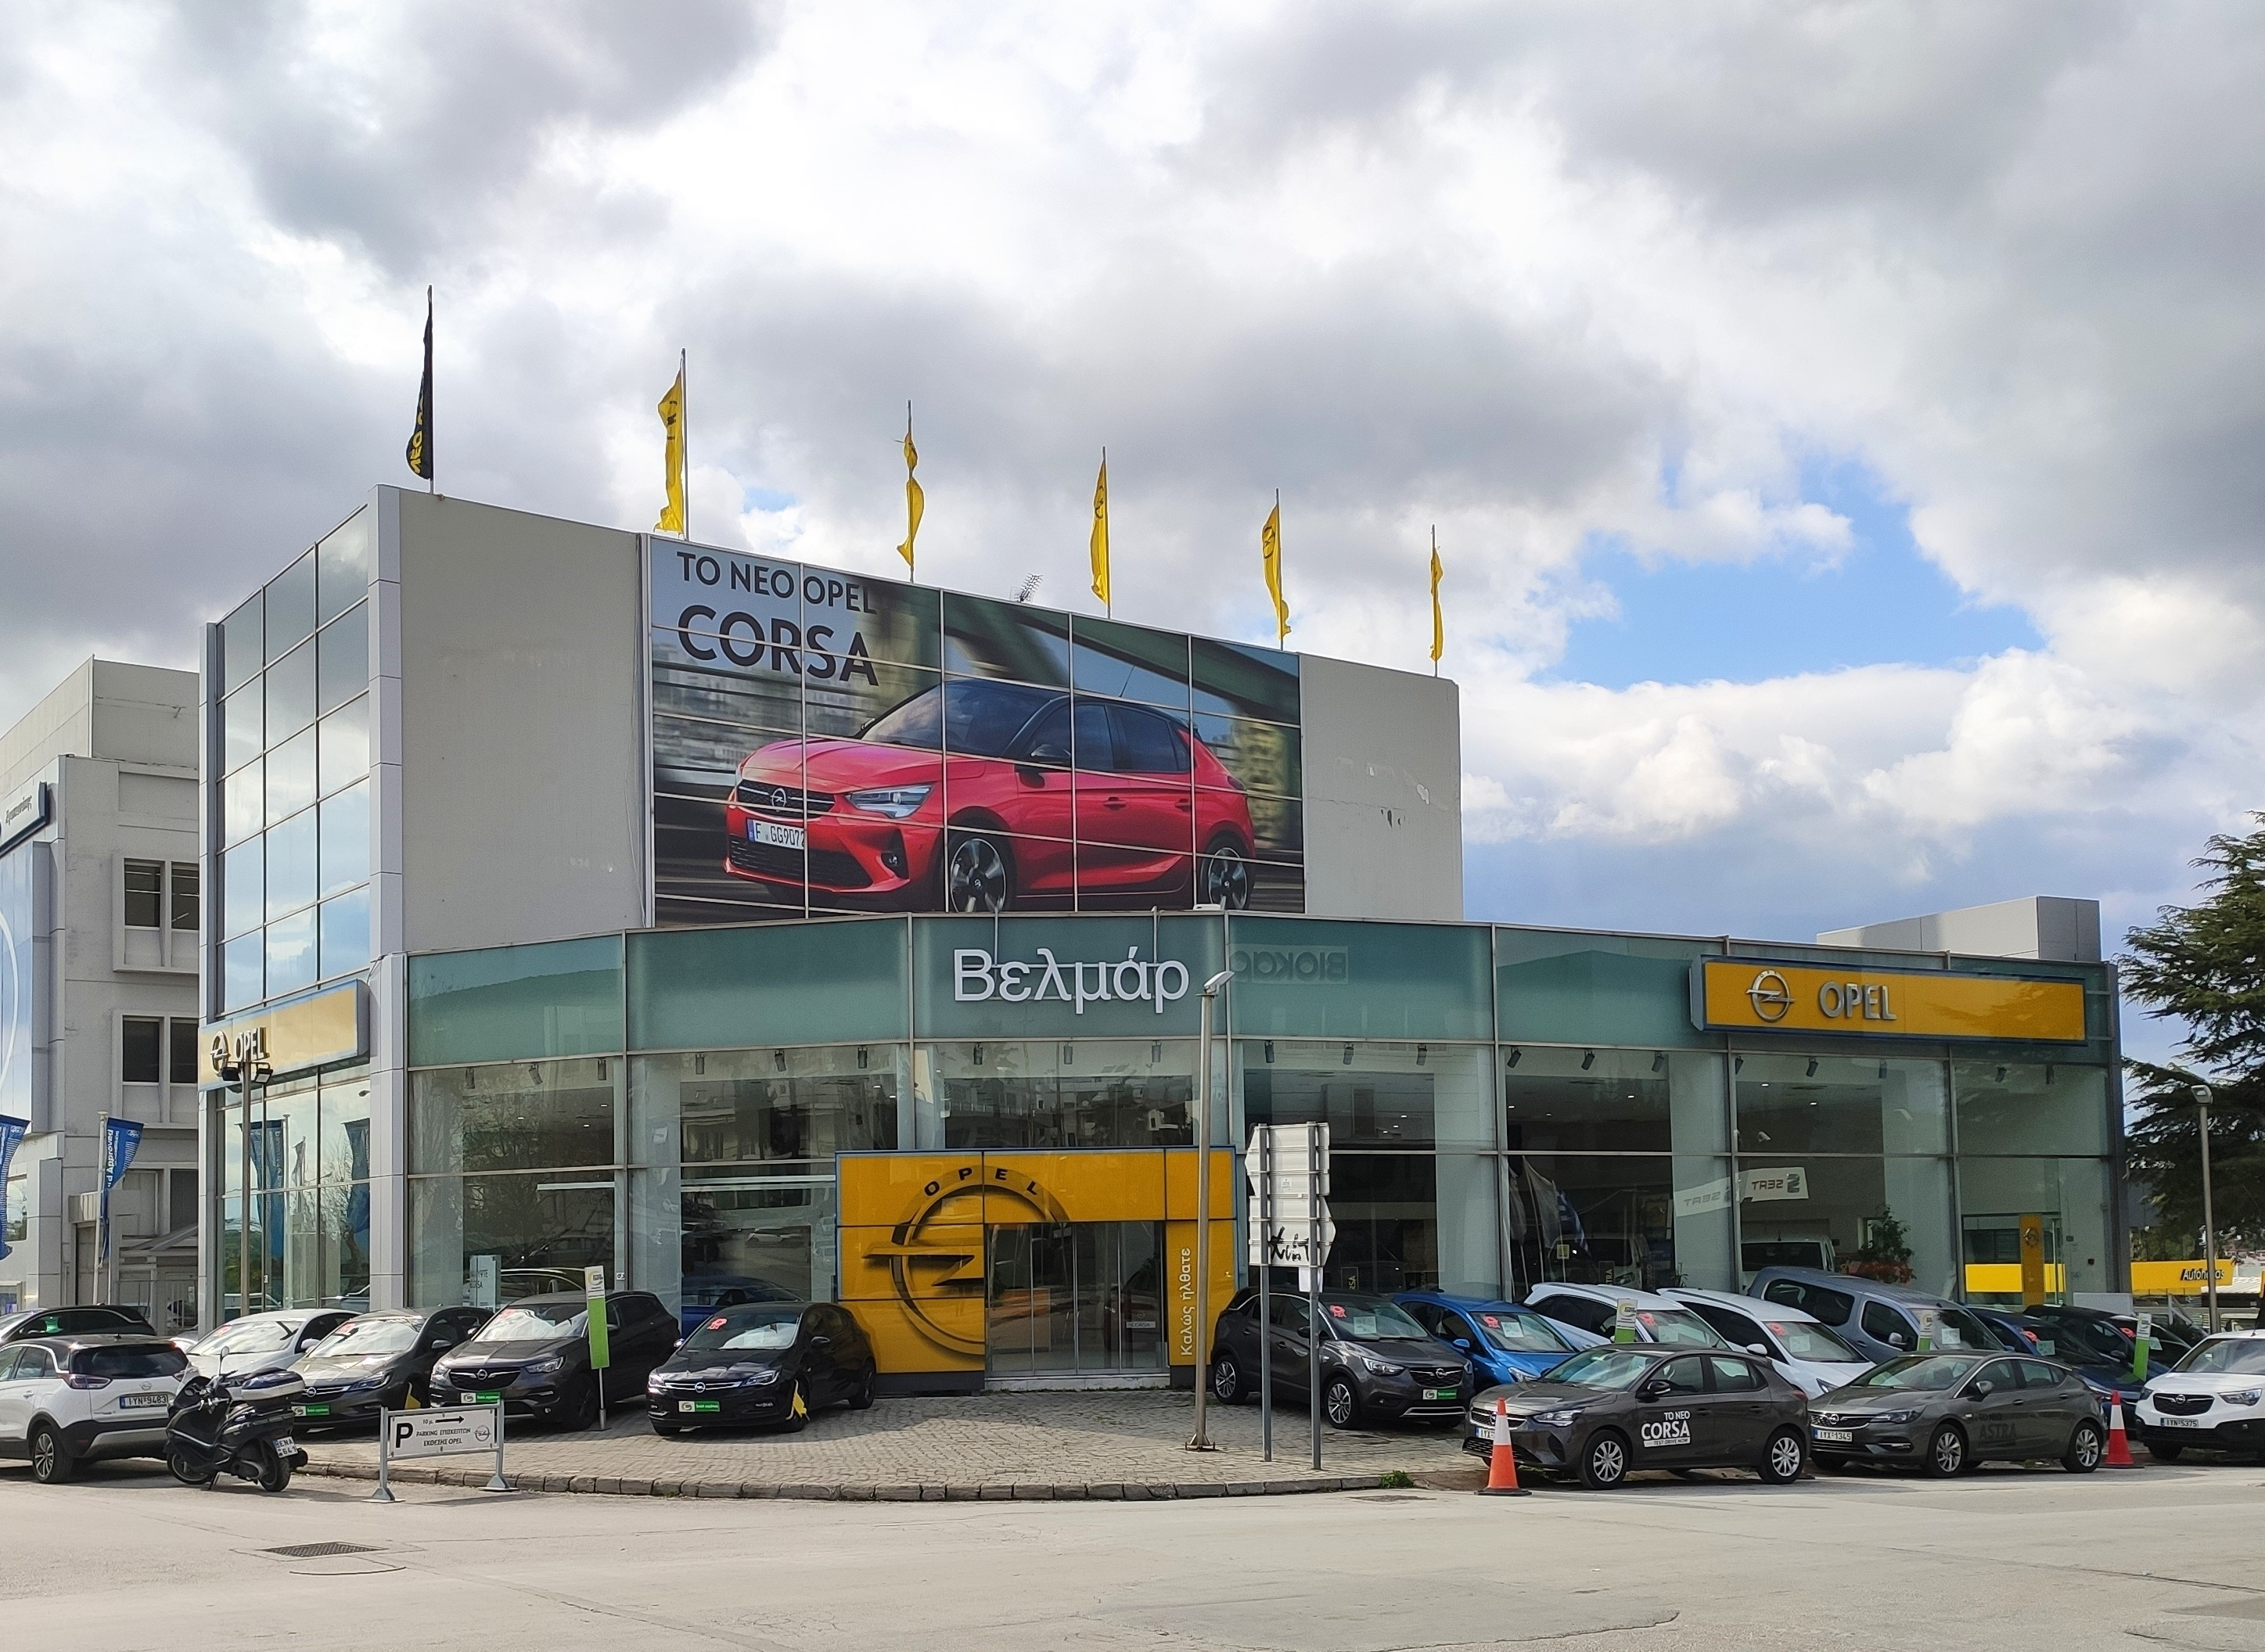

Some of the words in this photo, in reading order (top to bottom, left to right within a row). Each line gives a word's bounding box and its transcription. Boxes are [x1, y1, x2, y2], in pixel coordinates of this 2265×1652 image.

[677, 551, 721, 586] ΤΟ
[730, 560, 794, 599] ΝΕΟ
[804, 576, 878, 615] OPEL
[678, 605, 879, 687] CORSA
[954, 946, 1189, 1015] Βελμάρ
[1819, 981, 1897, 1020] OPEL
[235, 1027, 267, 1062] OPEL
[924, 1167, 1039, 1197] OPEL
[1179, 1248, 1195, 1301] ήλθατε
[1180, 1305, 1195, 1356] Καλώς
[395, 1422, 414, 1448] P
[1641, 1420, 1690, 1440] CORSA
[1663, 1412, 1674, 1421] ΤΟ
[1675, 1410, 1691, 1420] ΝΕΟ
